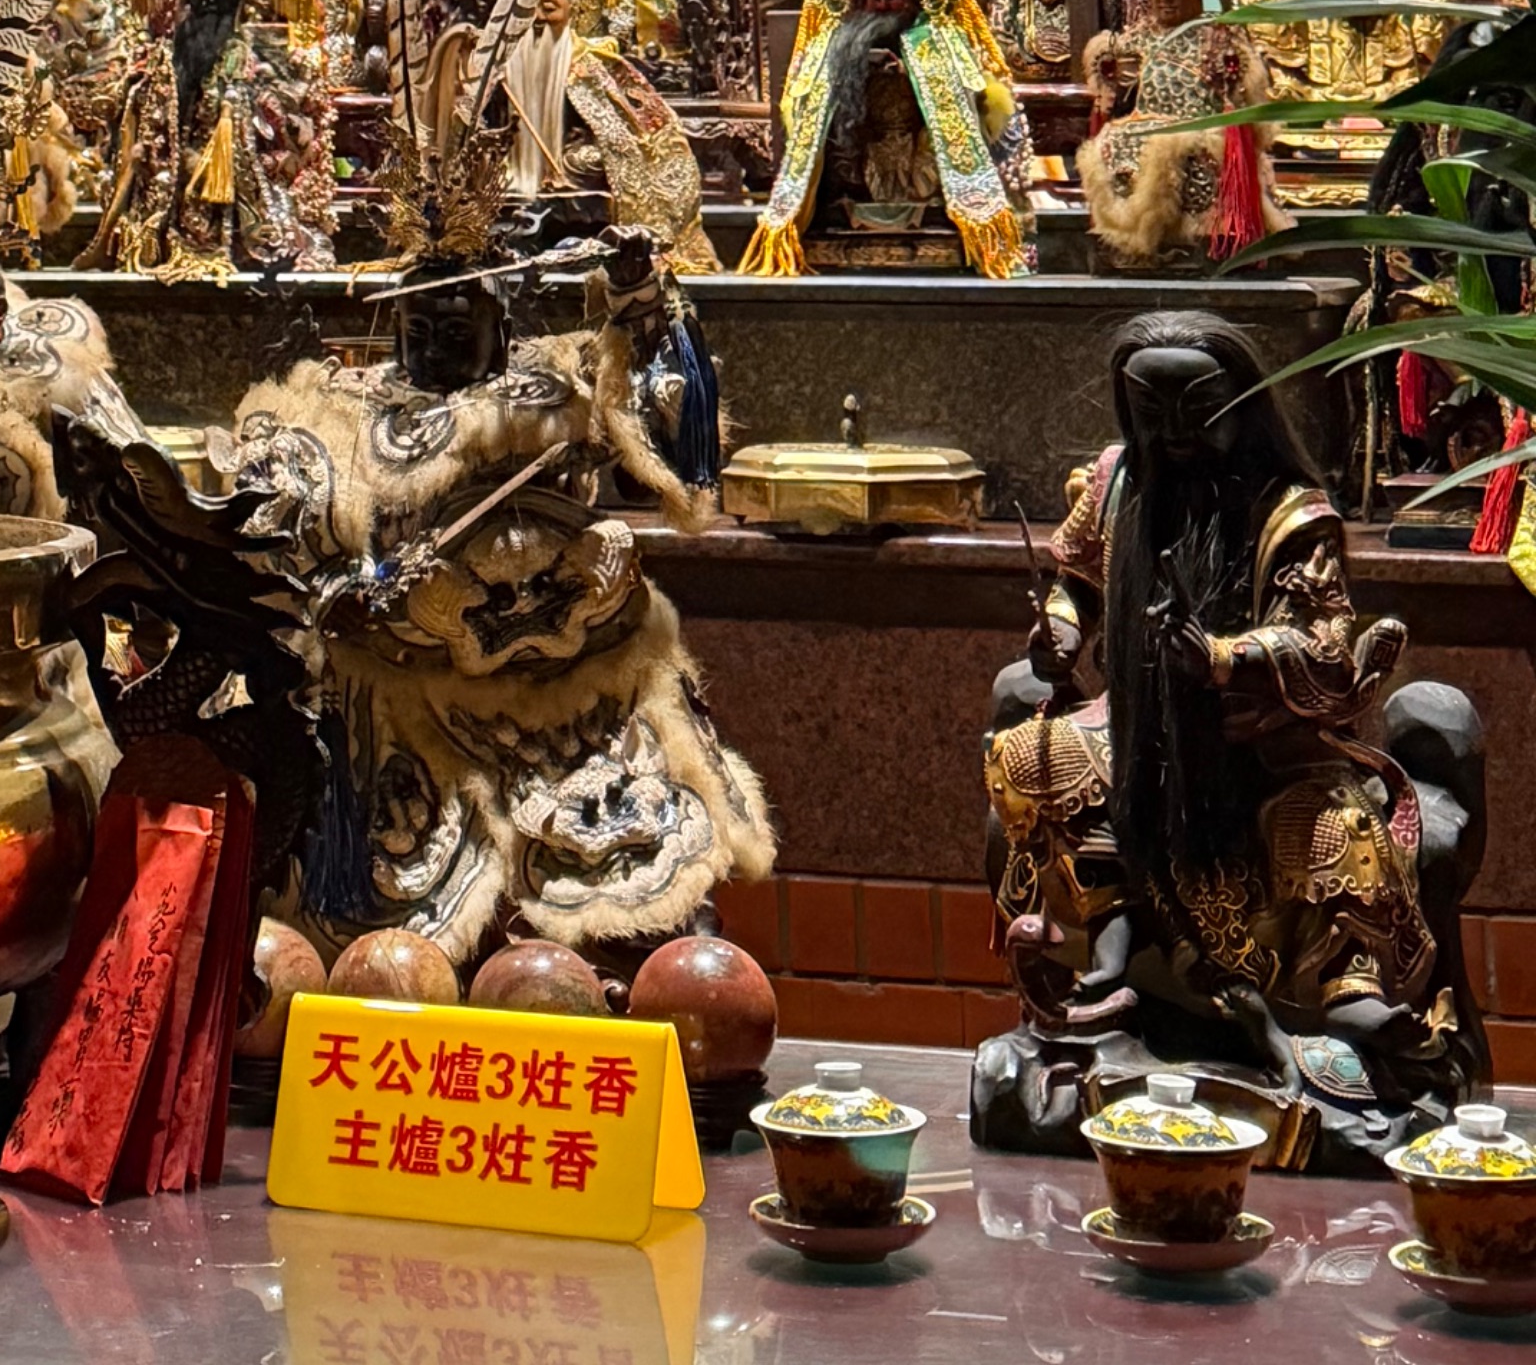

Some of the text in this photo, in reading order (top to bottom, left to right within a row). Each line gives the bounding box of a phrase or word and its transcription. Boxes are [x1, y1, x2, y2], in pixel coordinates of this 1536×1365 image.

[308, 1032, 638, 1118] 天公爐3炷香
[327, 1109, 599, 1193] 主爐3炷香
